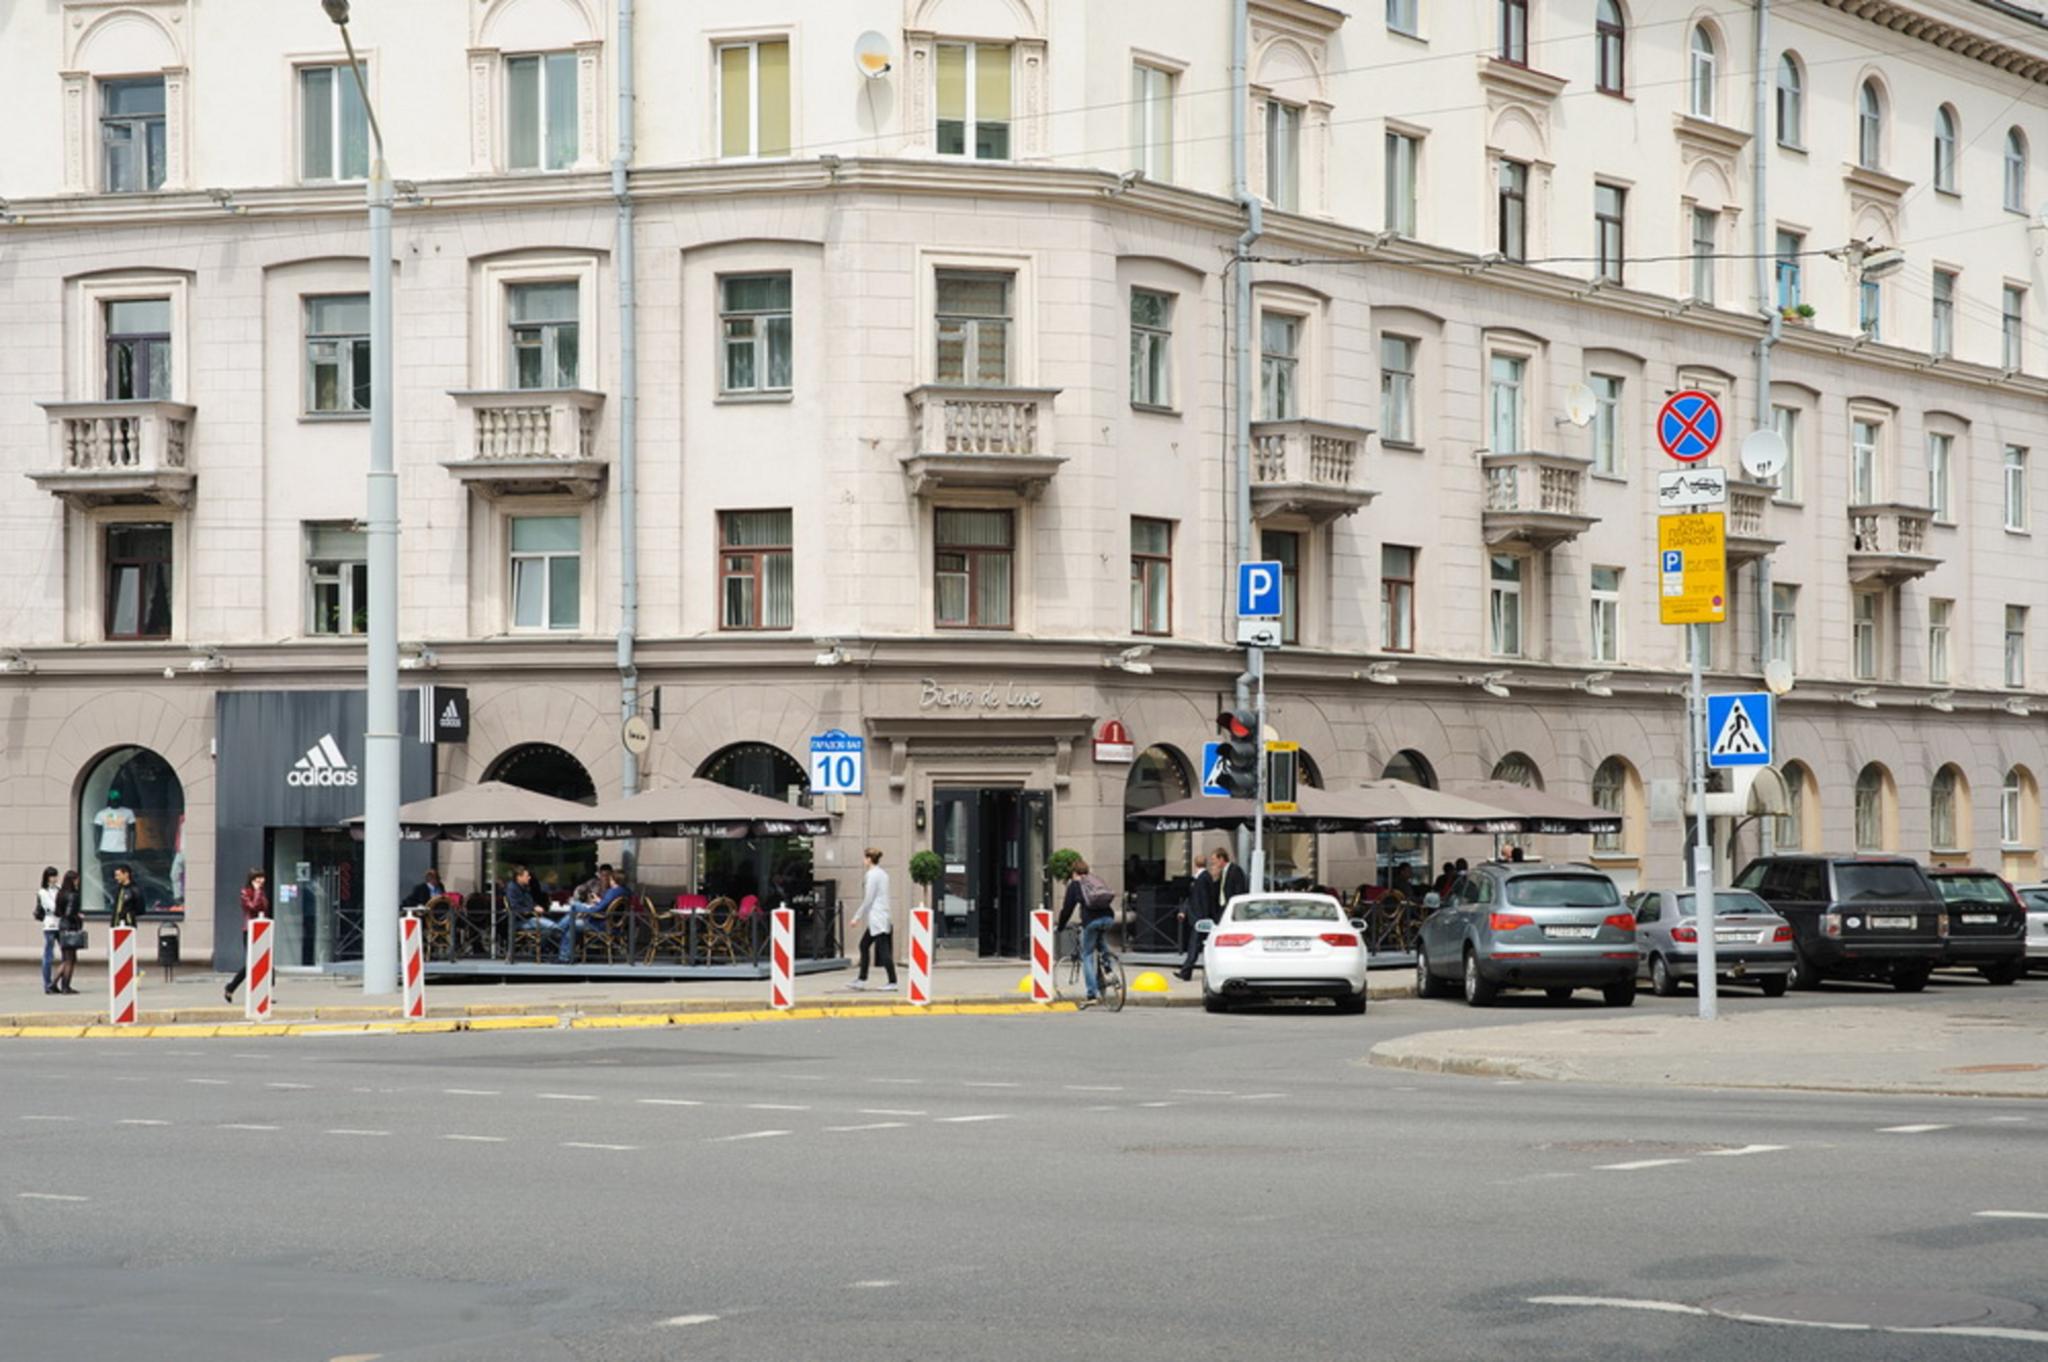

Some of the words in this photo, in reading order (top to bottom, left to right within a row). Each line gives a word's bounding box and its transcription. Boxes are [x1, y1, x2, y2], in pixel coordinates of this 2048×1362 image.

[1667, 552, 1679, 571] P
[1249, 568, 1272, 610] P
[981, 682, 1000, 706] de
[287, 767, 357, 786] adidas
[818, 755, 855, 787] 10
